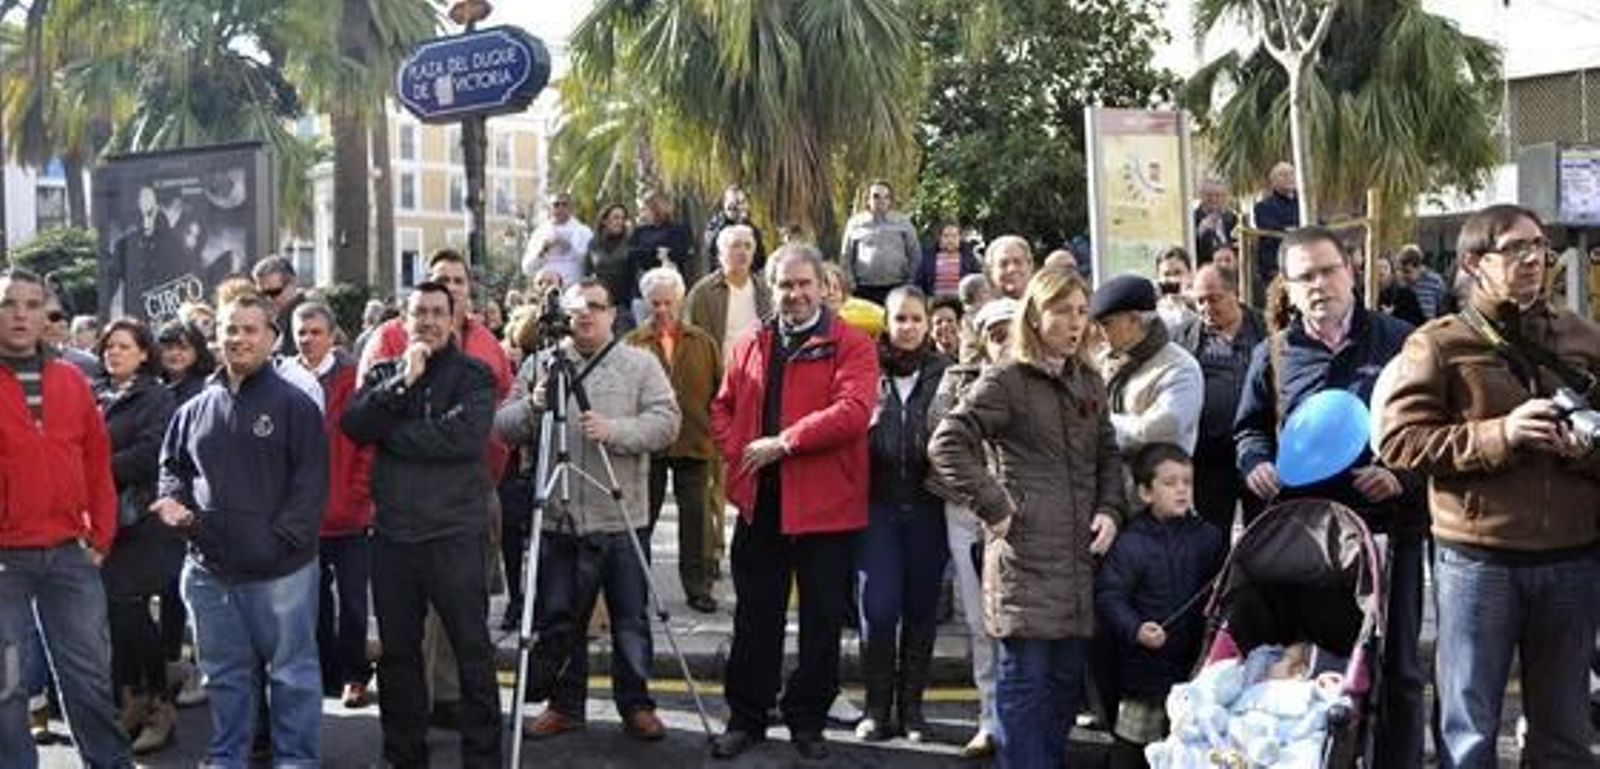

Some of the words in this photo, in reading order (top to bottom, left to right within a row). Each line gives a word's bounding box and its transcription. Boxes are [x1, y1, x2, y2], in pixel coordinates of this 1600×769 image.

[408, 61, 443, 81] PLAZA
[447, 56, 469, 73] DEL
[472, 48, 517, 68] DUQUE
[412, 82, 429, 100] DE
[454, 68, 513, 91] VICTORIA
[145, 278, 203, 319] CIRCO
